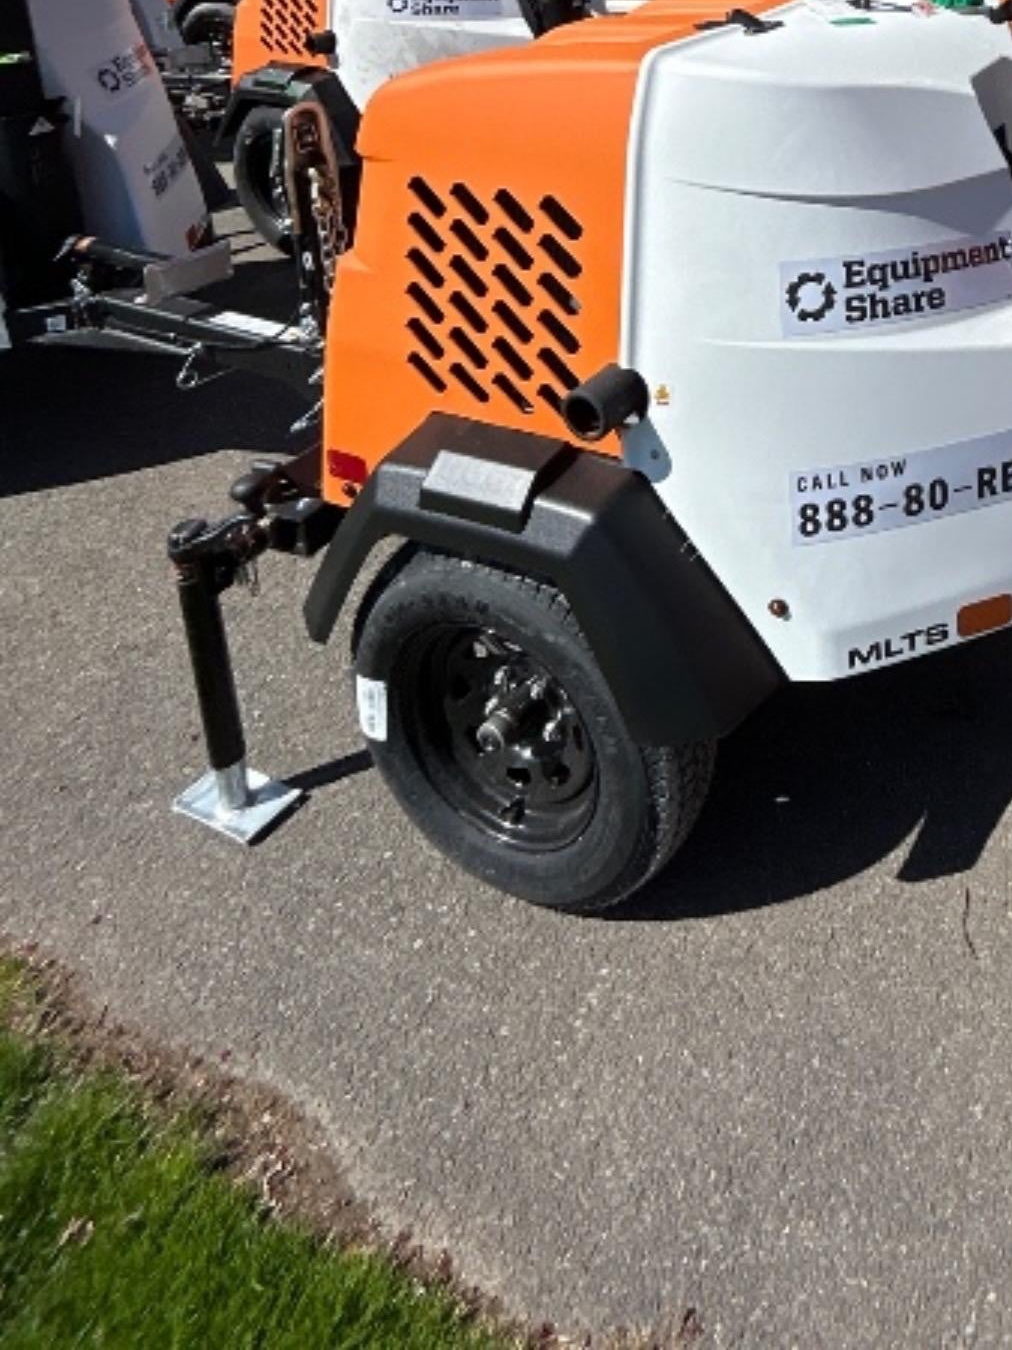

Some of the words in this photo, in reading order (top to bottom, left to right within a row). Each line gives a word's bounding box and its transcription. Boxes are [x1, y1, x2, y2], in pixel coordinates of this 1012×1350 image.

[842, 235, 1012, 290] Equipment
[845, 287, 945, 323] Share
[797, 469, 849, 493] CALL
[860, 458, 907, 483] NOW
[848, 623, 949, 670] MLTS
